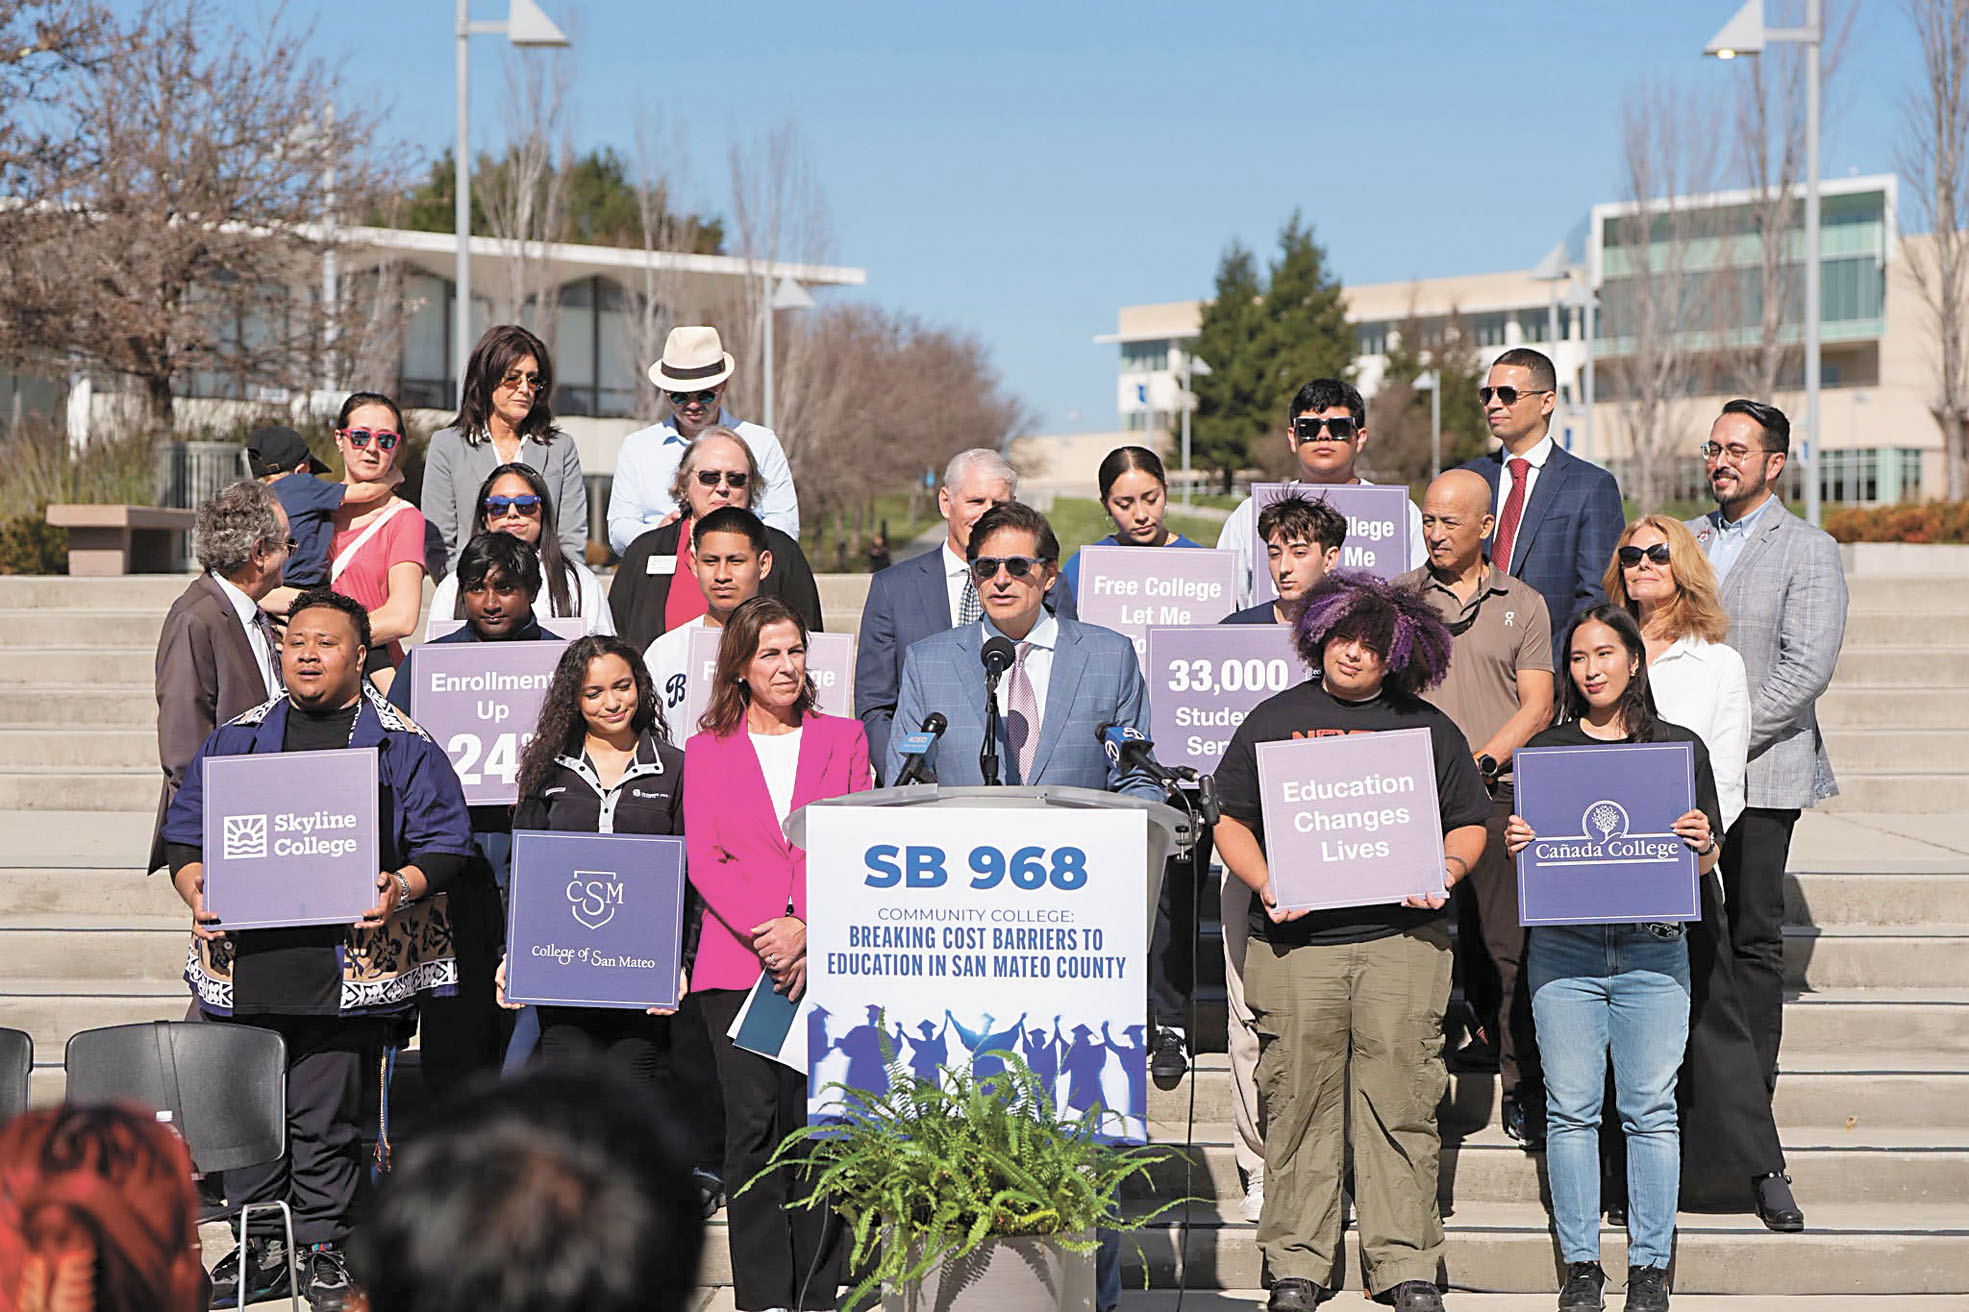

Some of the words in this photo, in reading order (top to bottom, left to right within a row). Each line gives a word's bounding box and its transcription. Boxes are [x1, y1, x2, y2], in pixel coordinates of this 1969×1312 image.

[1346, 517, 1395, 542] llege
[1344, 546, 1376, 568] Me
[1093, 575, 1139, 596] Free
[1145, 577, 1222, 602] College
[1121, 604, 1154, 625] Let
[1159, 605, 1191, 625] Me
[431, 671, 555, 692] Enrollment
[1168, 658, 1289, 696] 33,000
[665, 673, 687, 709] B
[477, 700, 510, 723] Up
[1175, 707, 1250, 727] Stude
[1282, 774, 1415, 803] Education
[274, 810, 357, 835] Skyline
[1294, 807, 1410, 833] Changes
[274, 836, 357, 857] College
[1321, 840, 1390, 863] Lives
[1535, 841, 1603, 859] Cañada
[1608, 840, 1679, 859] College
[864, 844, 948, 889] SB
[968, 845, 1088, 891] 968
[566, 880, 624, 916] CSM
[878, 908, 986, 922] COMMUNITY
[991, 909, 1075, 923] COLLEGE:
[849, 926, 936, 949] BREAKING
[943, 927, 987, 950] COST
[992, 928, 1078, 951] BARRIERS
[1083, 929, 1103, 951] TO
[532, 943, 575, 965] College
[577, 947, 590, 961] of
[591, 950, 616, 966] San
[619, 955, 656, 968] Mateo
[827, 953, 923, 977] EDUCATION
[929, 954, 946, 977] IN
[952, 955, 987, 978] SAN
[993, 955, 1051, 979] MATEO
[1056, 956, 1127, 979] COUNTY
